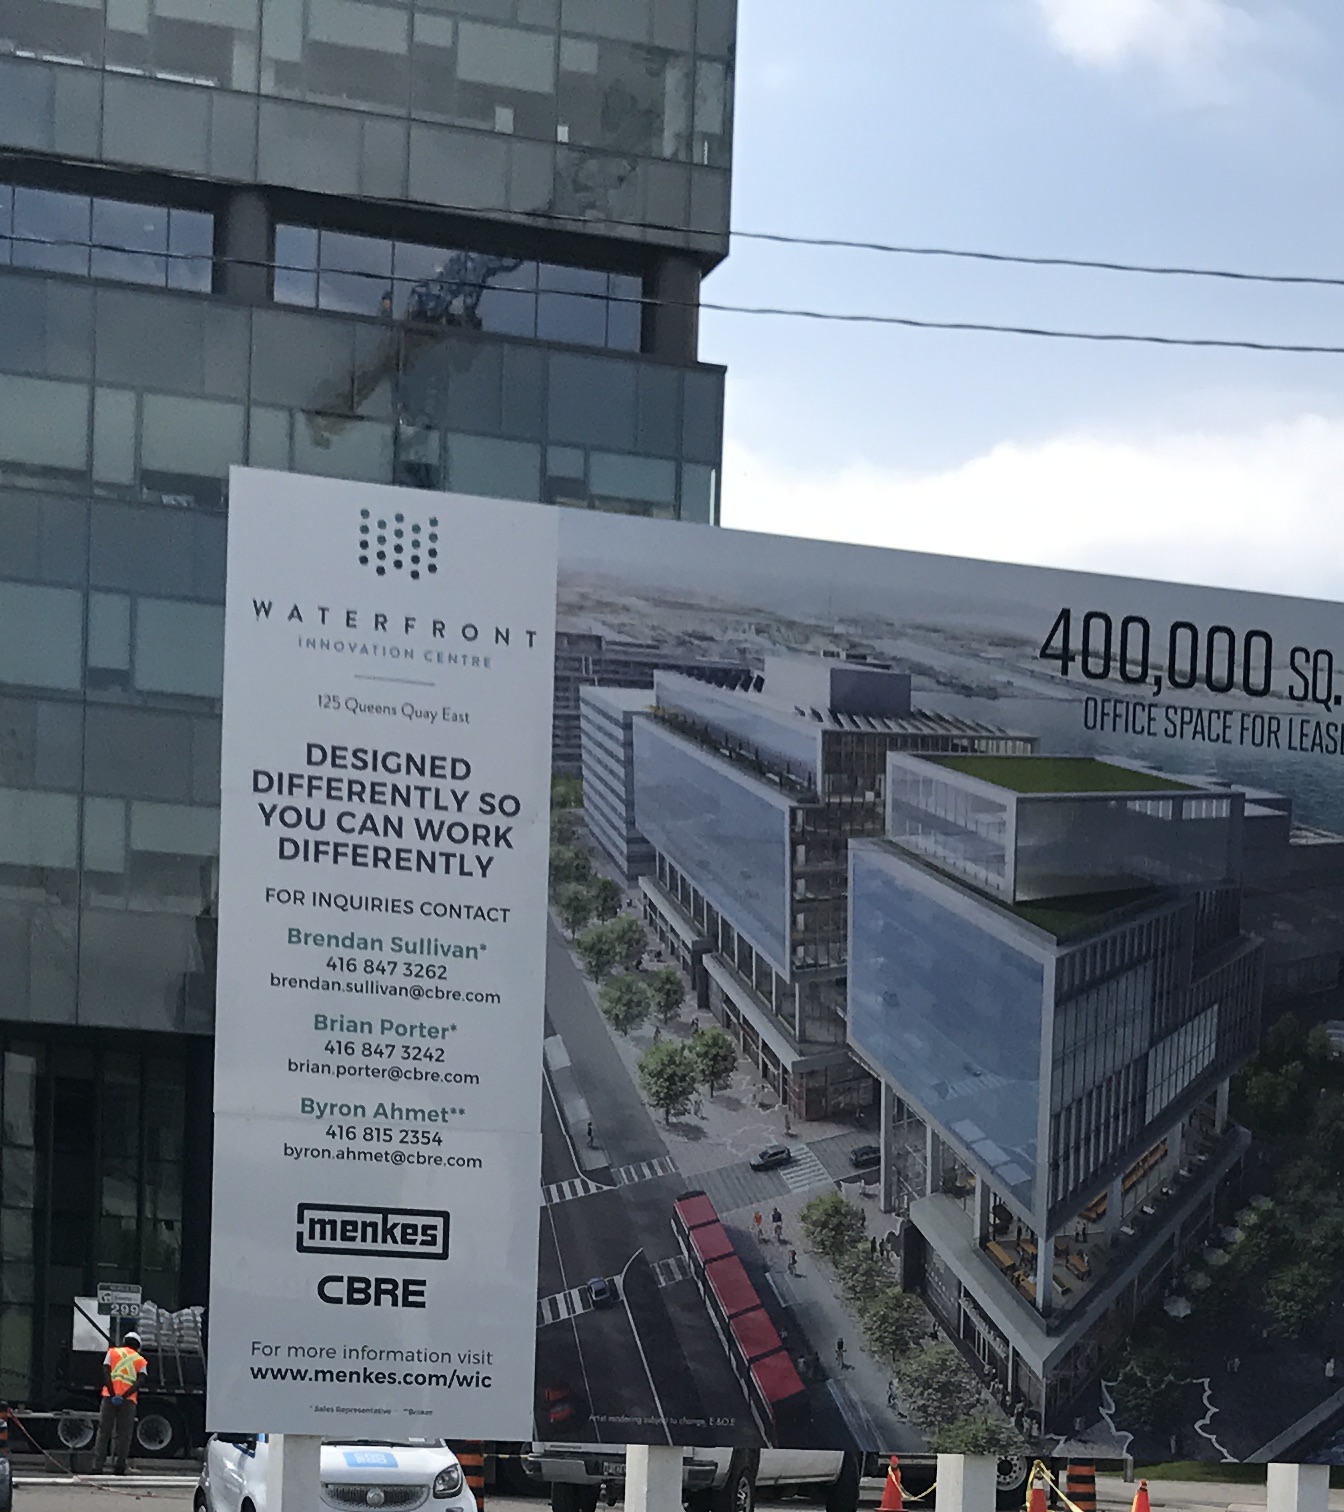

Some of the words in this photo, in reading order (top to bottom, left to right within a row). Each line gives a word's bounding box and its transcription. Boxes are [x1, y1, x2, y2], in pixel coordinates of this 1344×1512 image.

[253, 598, 537, 648] WATERFRONT
[298, 636, 414, 660] INNOVATION
[424, 651, 491, 669] CENTRE
[1039, 607, 1273, 697] 400,000
[1289, 646, 1342, 712] SQ.
[317, 694, 341, 710] 125
[345, 698, 397, 716] Queens
[401, 703, 438, 724] Quay
[442, 707, 470, 724] East
[1084, 697, 1157, 737] OFFICE
[1164, 705, 1233, 744] SPACE
[1240, 713, 1280, 750] FOR
[306, 743, 471, 781] DESIGNED
[252, 769, 471, 813] DIFFERENTLY
[478, 792, 521, 817] SO
[257, 802, 326, 832] YOU
[336, 811, 403, 839] CAN
[414, 818, 515, 850] WORK
[278, 837, 493, 878] DIFFERENTLY
[265, 887, 306, 906] FOR
[312, 891, 414, 916] INQUIRIES
[419, 901, 511, 923] CONTACT
[287, 927, 383, 953] Brendan
[326, 956, 357, 973] 416
[363, 958, 397, 976] 847
[403, 961, 447, 981] 3262
[270, 972, 501, 1004] brendan.sullivan@cbre.com
[314, 1013, 373, 1035] Brian
[324, 1039, 355, 1057] 416
[361, 1041, 396, 1060] 847
[400, 1044, 446, 1063] 3242
[288, 1058, 480, 1085] brian.porter@cbre.com
[300, 1097, 367, 1120] Byron
[325, 1125, 357, 1142] 416
[362, 1126, 393, 1144] 815
[399, 1129, 443, 1147] 2354
[283, 1143, 482, 1169] byron.ahmet@cbre.com
[308, 1214, 438, 1247] menkes
[317, 1275, 427, 1309] CBRE
[110, 1303, 139, 1316] 299
[251, 1341, 281, 1357] For
[287, 1345, 337, 1360] more
[343, 1344, 452, 1364] information
[458, 1350, 493, 1365] visit
[250, 1365, 492, 1389] www.menkes.com/wic
